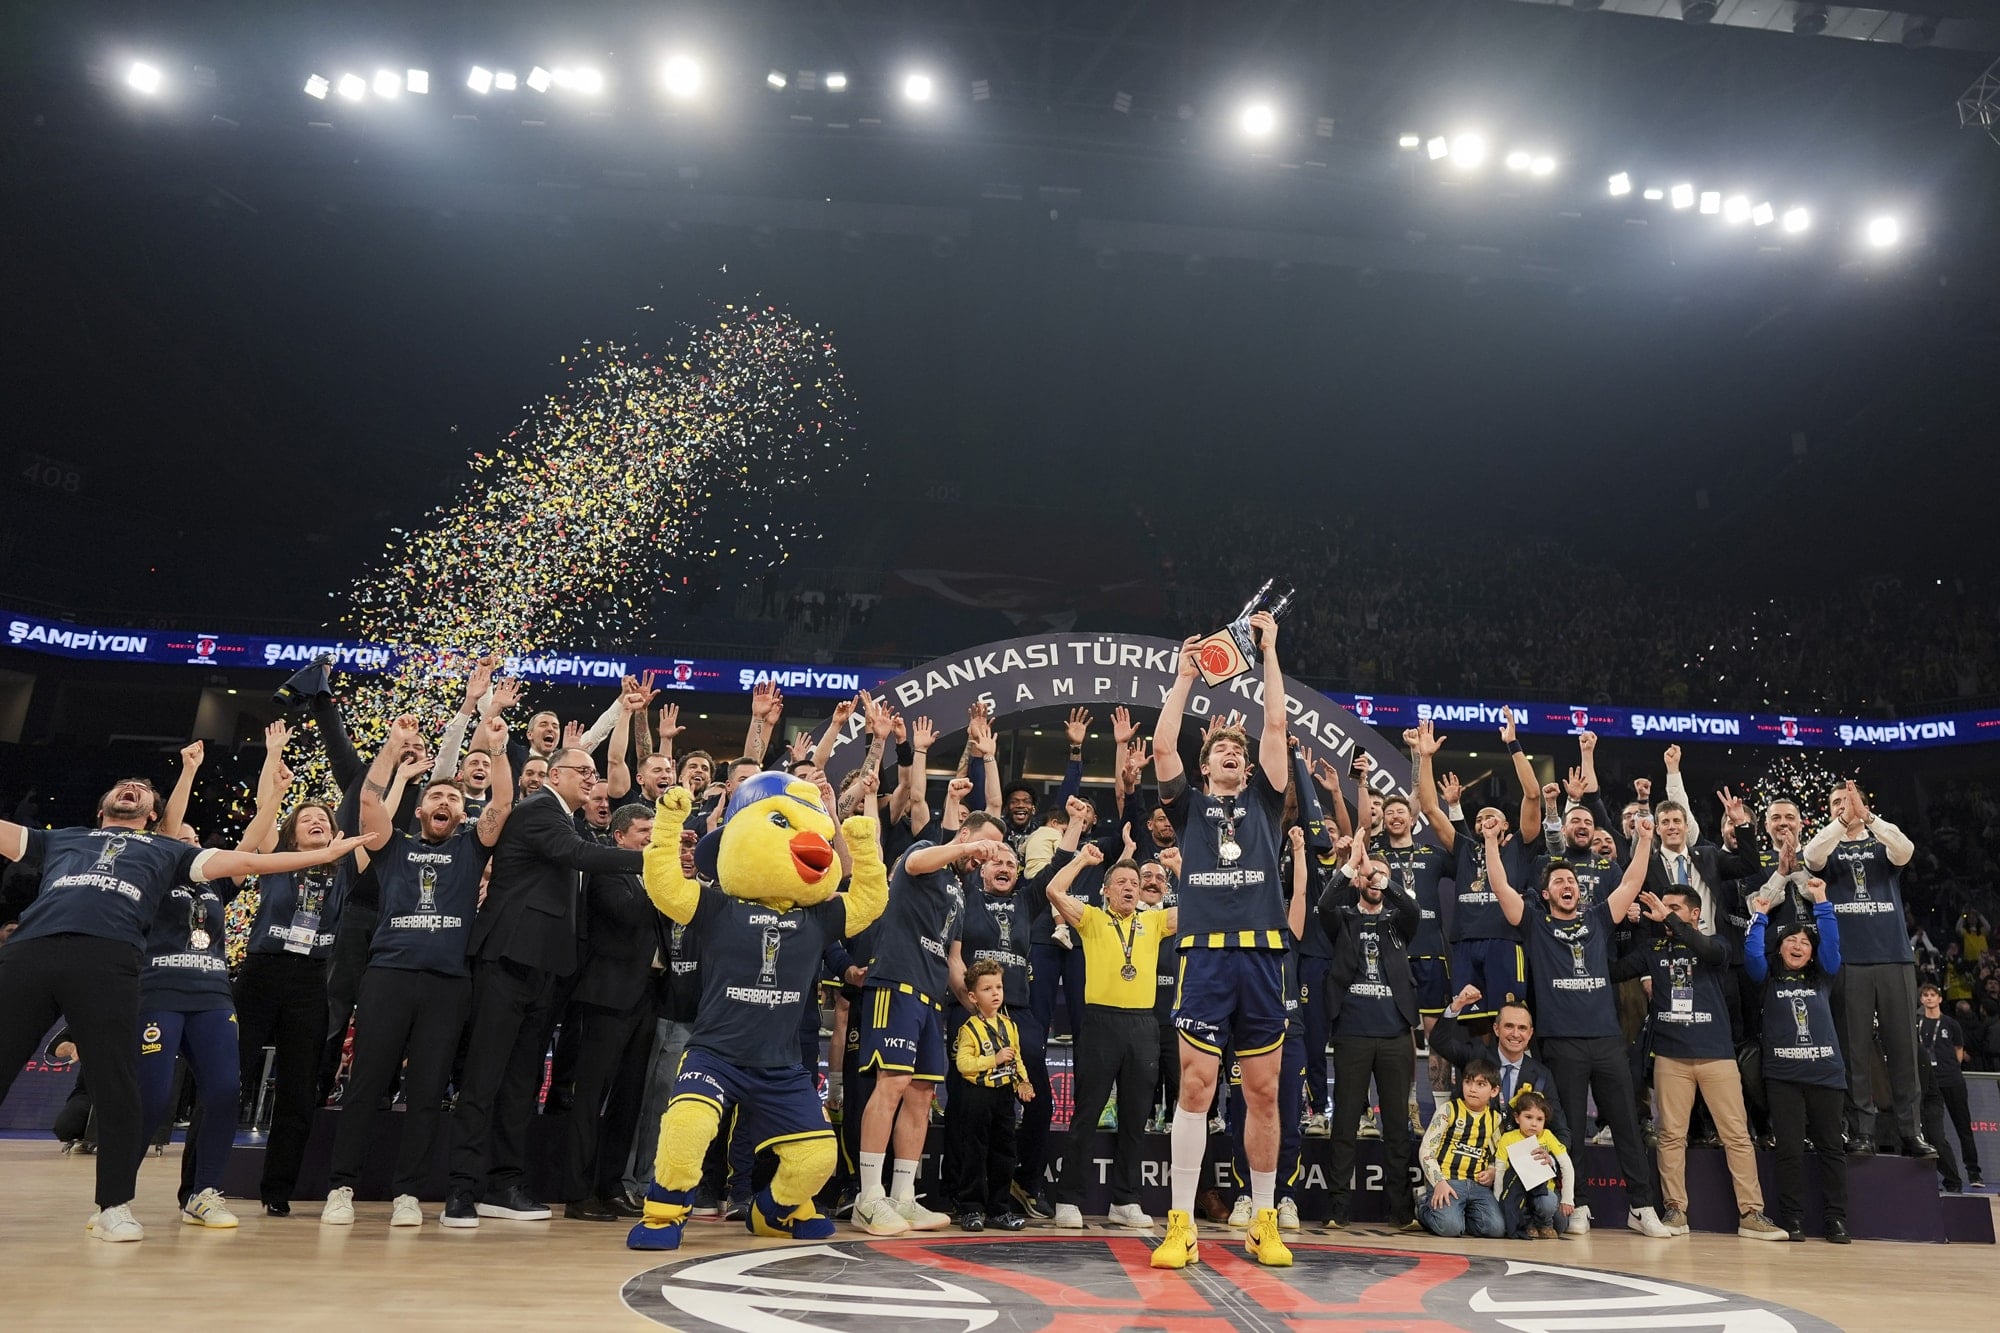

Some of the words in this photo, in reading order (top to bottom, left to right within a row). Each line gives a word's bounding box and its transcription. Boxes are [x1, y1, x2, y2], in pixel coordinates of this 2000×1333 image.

[8, 620, 148, 654] ŞAMPİYON
[263, 643, 391, 667] ŞAMPİYON
[738, 667, 859, 691] ŞAMPİYON
[895, 643, 1059, 709] BANKASI
[1068, 636, 1182, 674] TÜRKİ
[1631, 714, 1740, 736] ŞAMPİYON
[1838, 721, 1956, 746] ŞAMPİYON
[1188, 870, 1245, 891] FENERBAHÇE
[390, 914, 442, 932] FENERBAHÇE
[151, 952, 212, 973] FENERBAHÇE
[726, 986, 783, 1009] FENERBAHÇE
[884, 1037, 905, 1049] YKT
[1773, 1046, 1821, 1062] FENERBAHÇE
